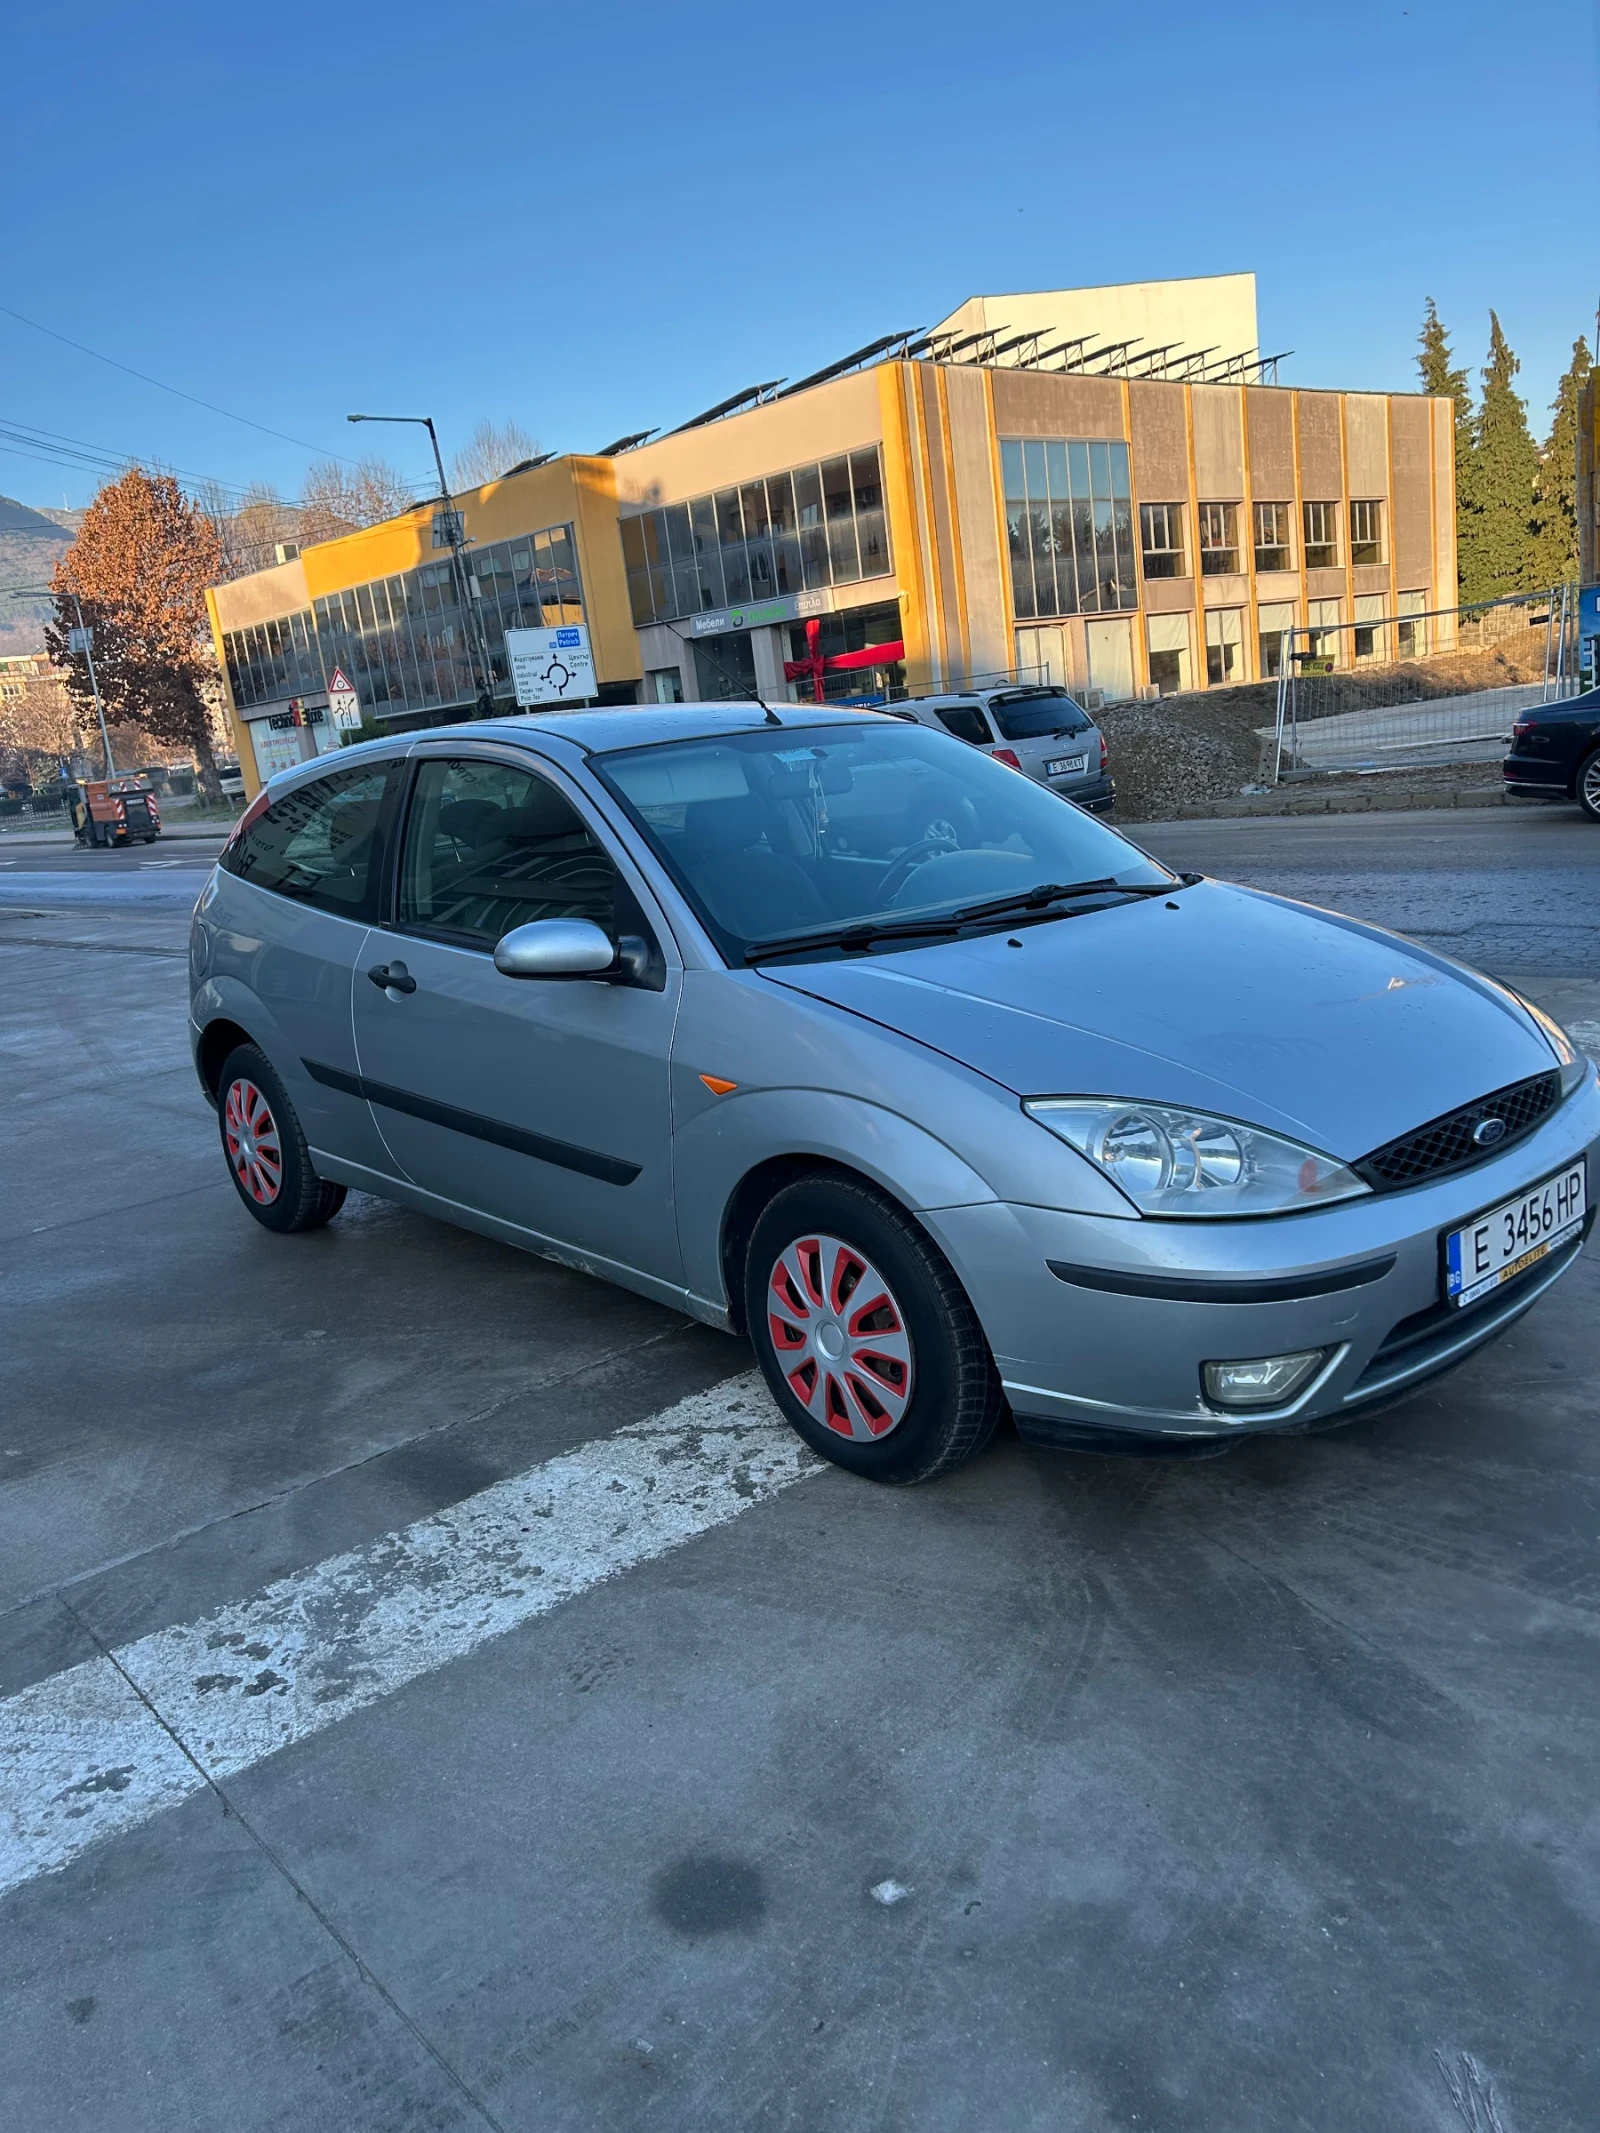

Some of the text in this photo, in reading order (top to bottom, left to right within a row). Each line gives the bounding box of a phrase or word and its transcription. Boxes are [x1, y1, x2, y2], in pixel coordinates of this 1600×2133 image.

[695, 617, 725, 631] Мебели
[557, 631, 578, 639] Петрич
[558, 638, 580, 646] Petrich
[568, 653, 590, 662] Център
[1473, 1223, 1490, 1274] E
[1502, 1244, 1548, 1279] AUTOELITE
[1449, 1270, 1461, 1286] BG
